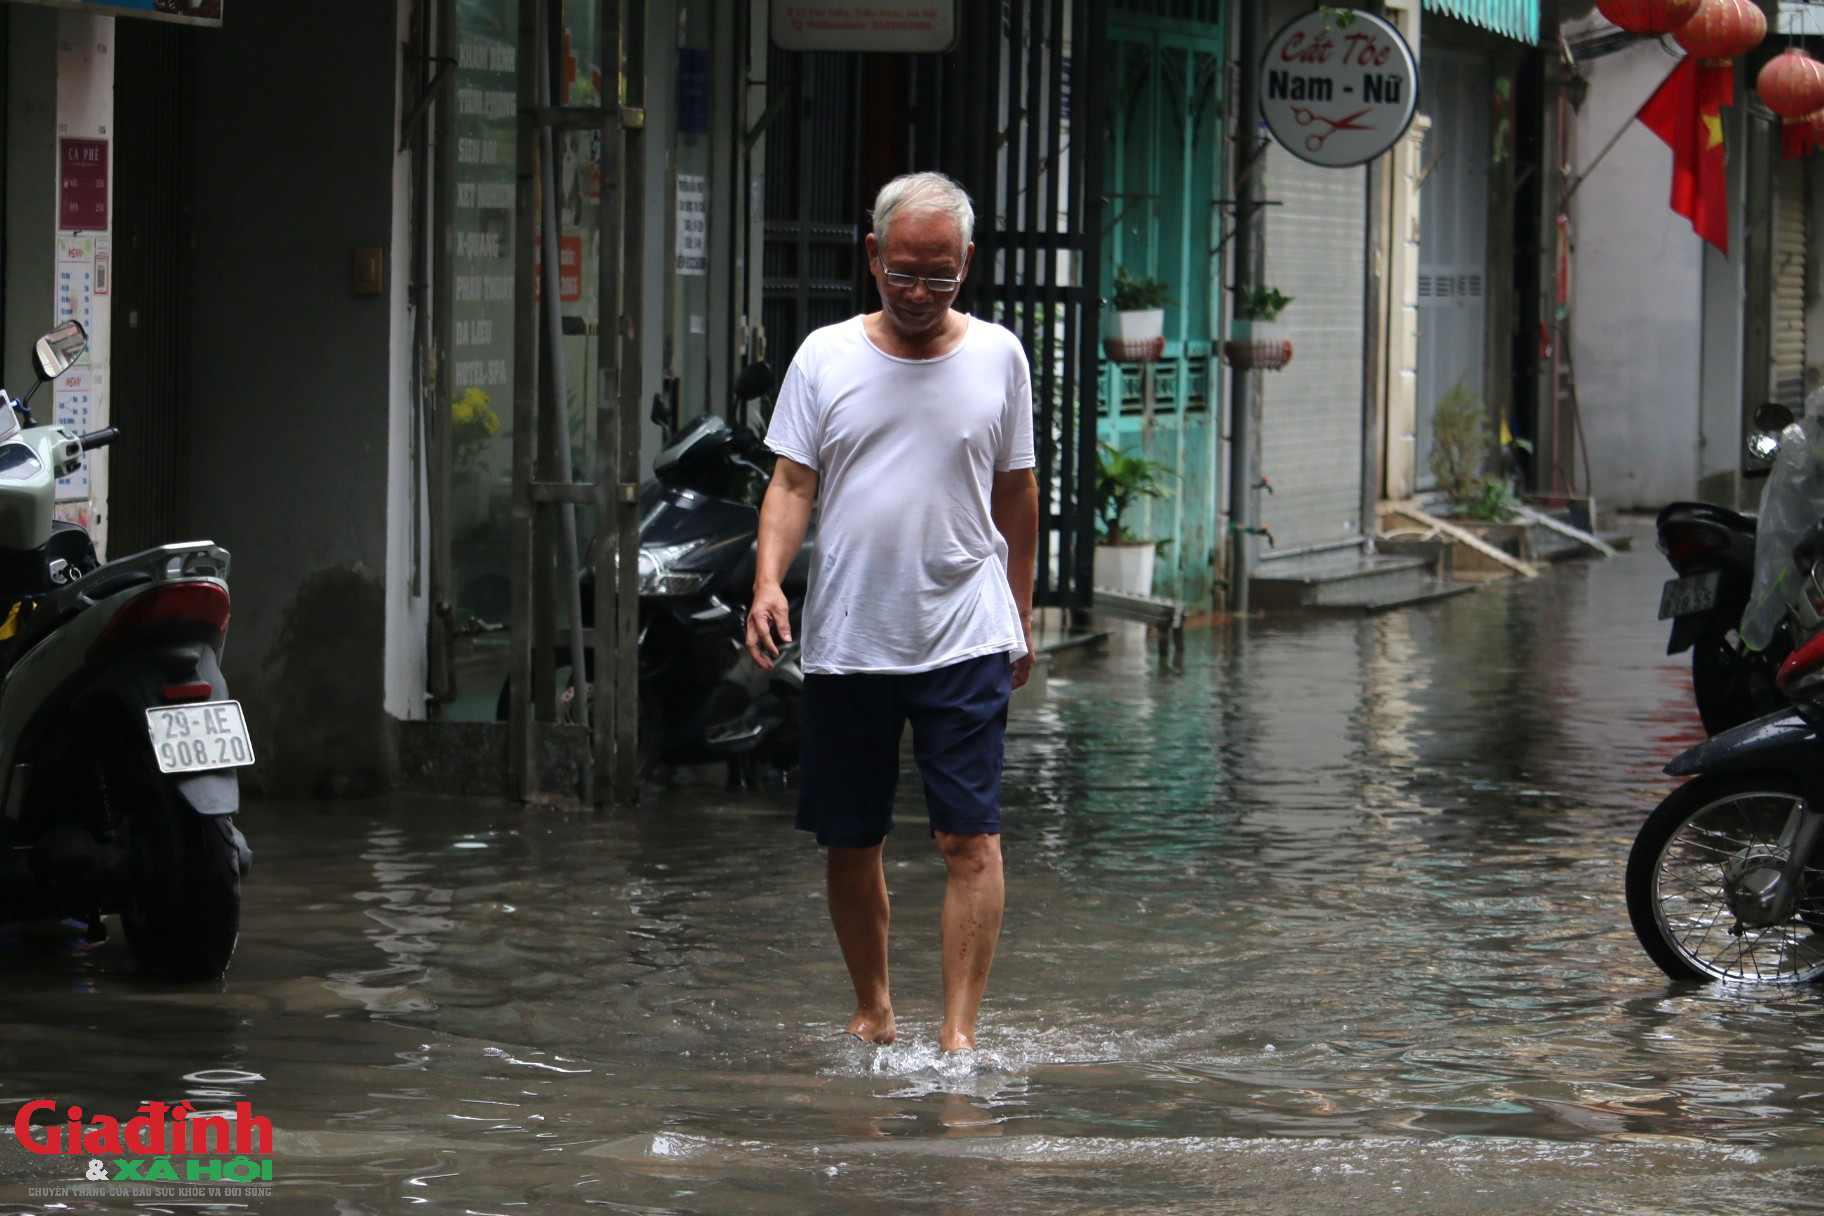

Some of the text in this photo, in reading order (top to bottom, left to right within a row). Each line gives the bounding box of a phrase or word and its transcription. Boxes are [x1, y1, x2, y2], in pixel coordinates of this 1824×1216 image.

[1268, 70, 1333, 101] Nam
[1363, 74, 1403, 104] Nữ
[161, 707, 231, 739] 29-AE
[161, 736, 246, 768] 908.20
